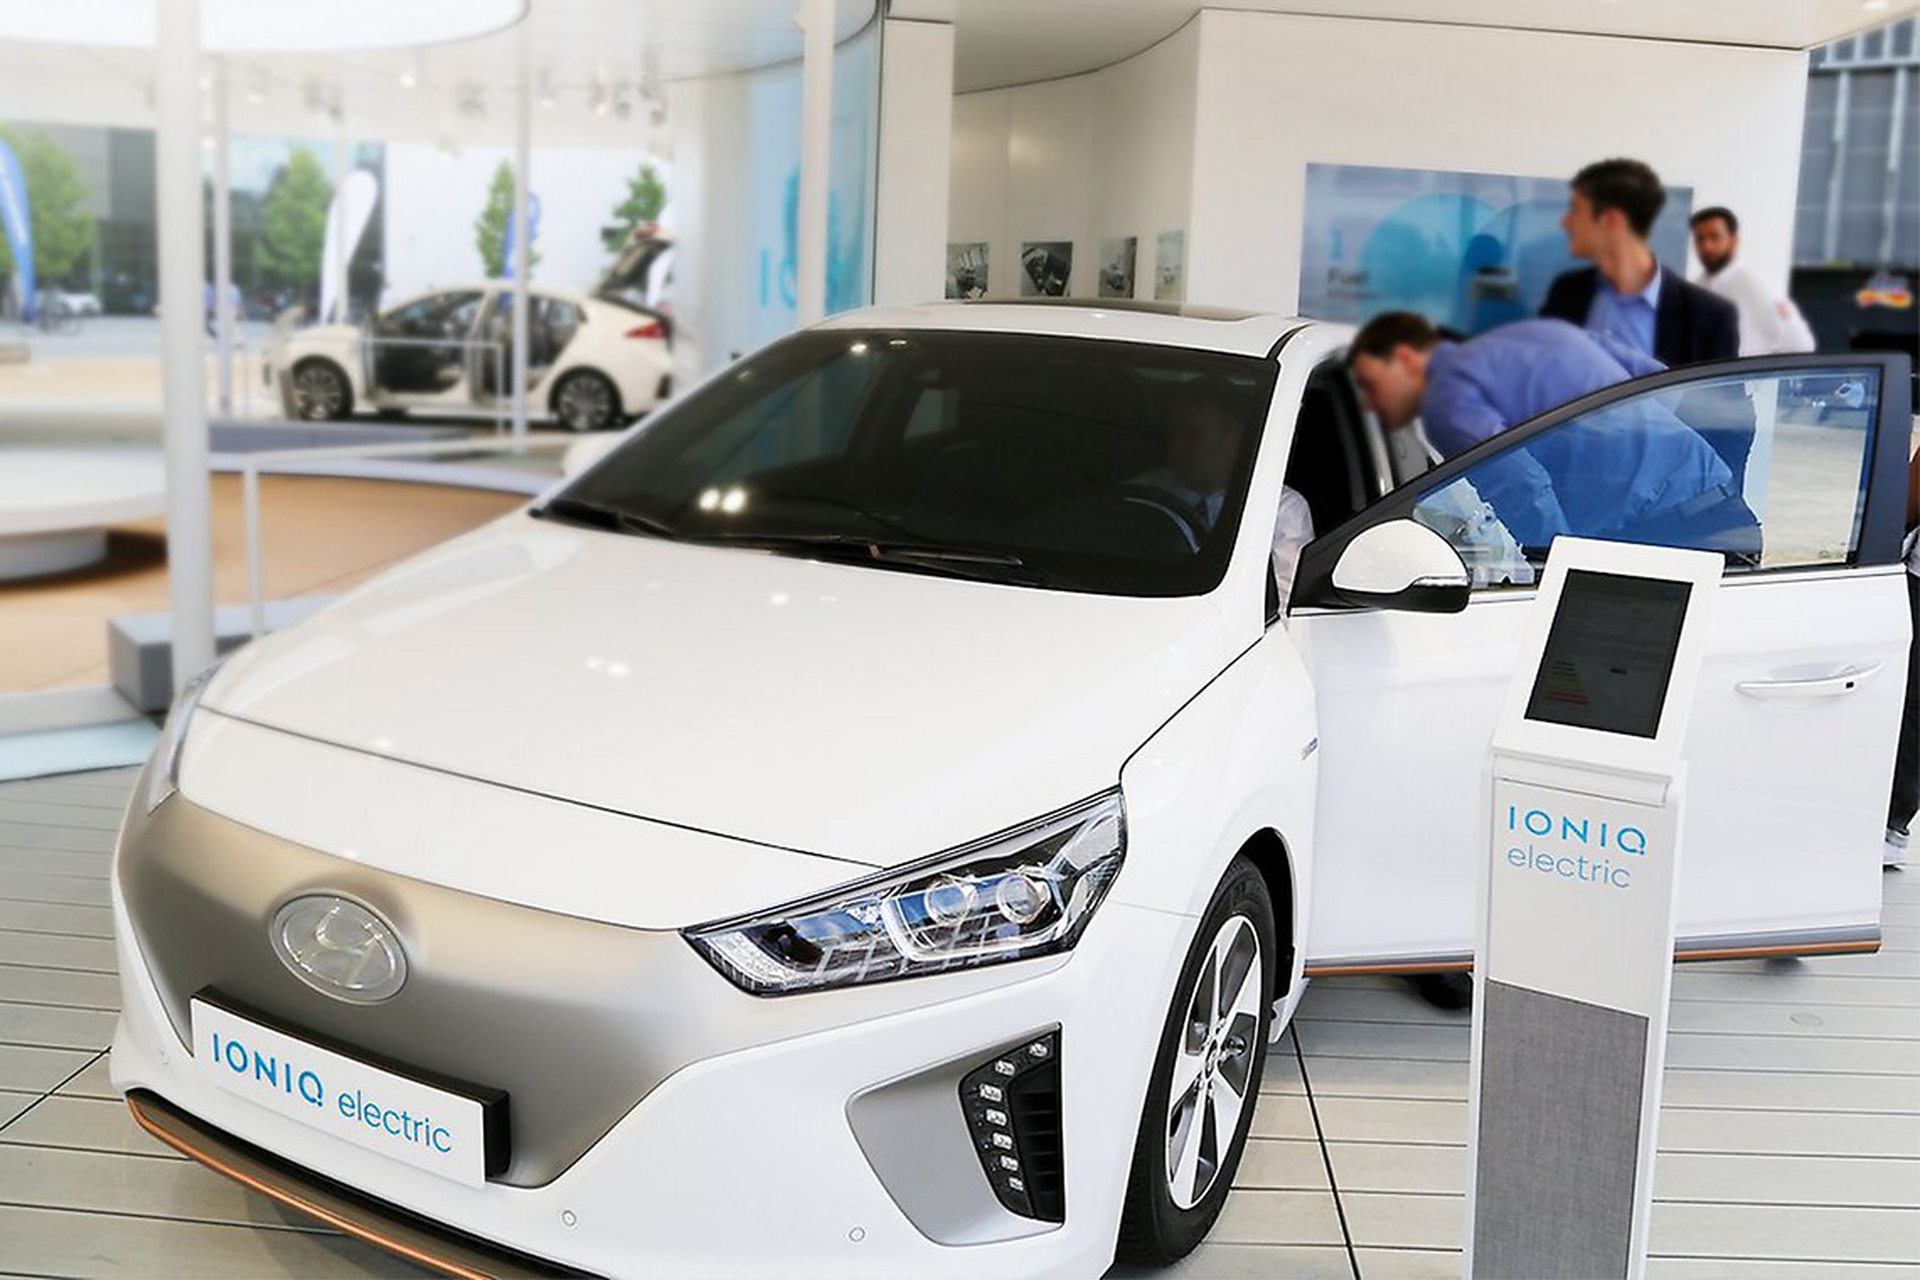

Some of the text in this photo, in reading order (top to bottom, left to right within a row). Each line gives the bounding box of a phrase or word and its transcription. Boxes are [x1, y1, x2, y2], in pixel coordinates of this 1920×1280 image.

[1509, 805, 1646, 855] IONIQ
[1508, 845, 1631, 888] electric
[213, 1032, 452, 1153] IONIQ electric
